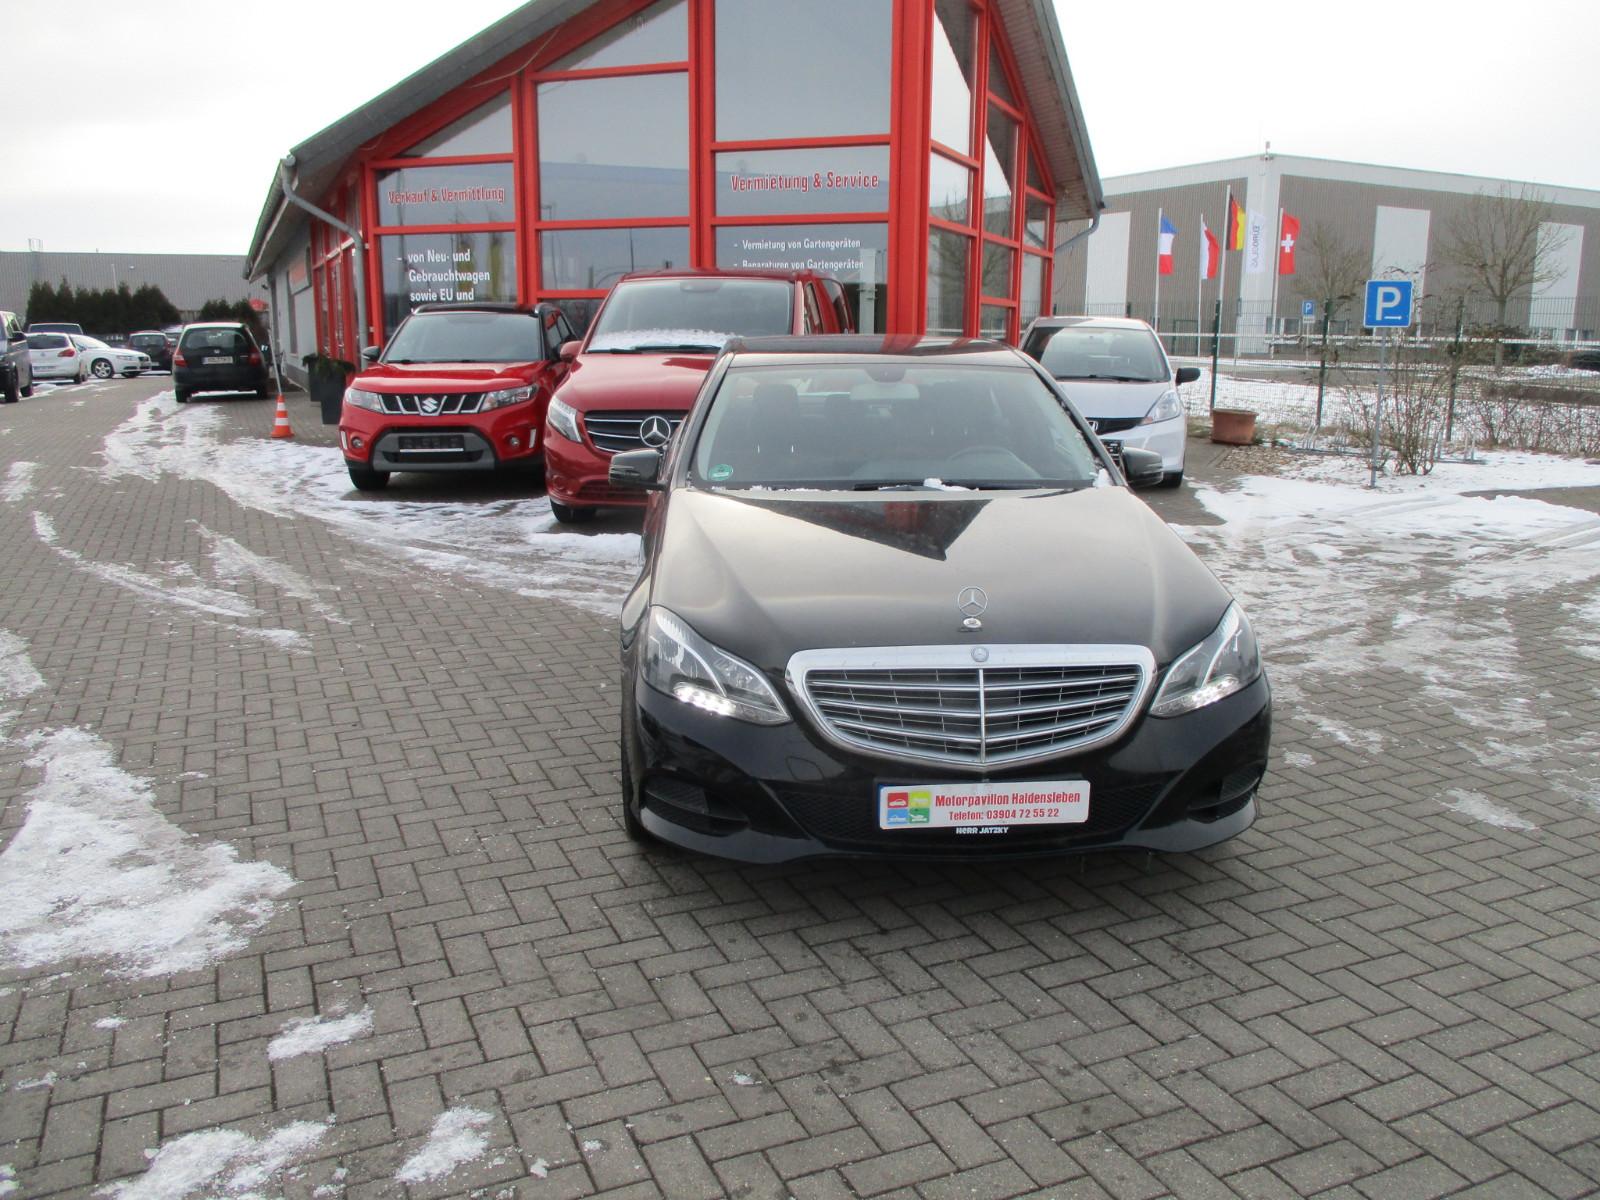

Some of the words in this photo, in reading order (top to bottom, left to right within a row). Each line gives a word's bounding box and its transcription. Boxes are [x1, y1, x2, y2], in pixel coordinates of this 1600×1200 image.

[731, 174, 809, 193] Vermietung
[813, 172, 822, 188] &
[827, 170, 880, 188] Service
[388, 189, 428, 205] Verkauf
[431, 189, 438, 203] &
[441, 186, 505, 206] Vermittlung
[742, 239, 786, 251] Vermietung
[788, 241, 802, 250] von
[803, 237, 861, 251] Gartengeräten
[408, 253, 425, 263] von
[427, 249, 449, 263] Neu-
[452, 248, 471, 262] und
[791, 260, 805, 270] von
[807, 258, 864, 272] Gartengeräten
[408, 269, 490, 285] Gebrauchtwagen
[410, 288, 437, 302] sowie
[440, 288, 453, 301] EU
[456, 288, 474, 301] und
[1375, 286, 1402, 321] P
[935, 794, 1009, 807] Motorpavillon
[1012, 791, 1080, 805] Haldensleben
[949, 810, 984, 821] Telefon:
[986, 809, 1016, 820] 03904
[1020, 809, 1031, 819] 72
[1033, 808, 1045, 818] 55
[1047, 808, 1060, 818] 22
